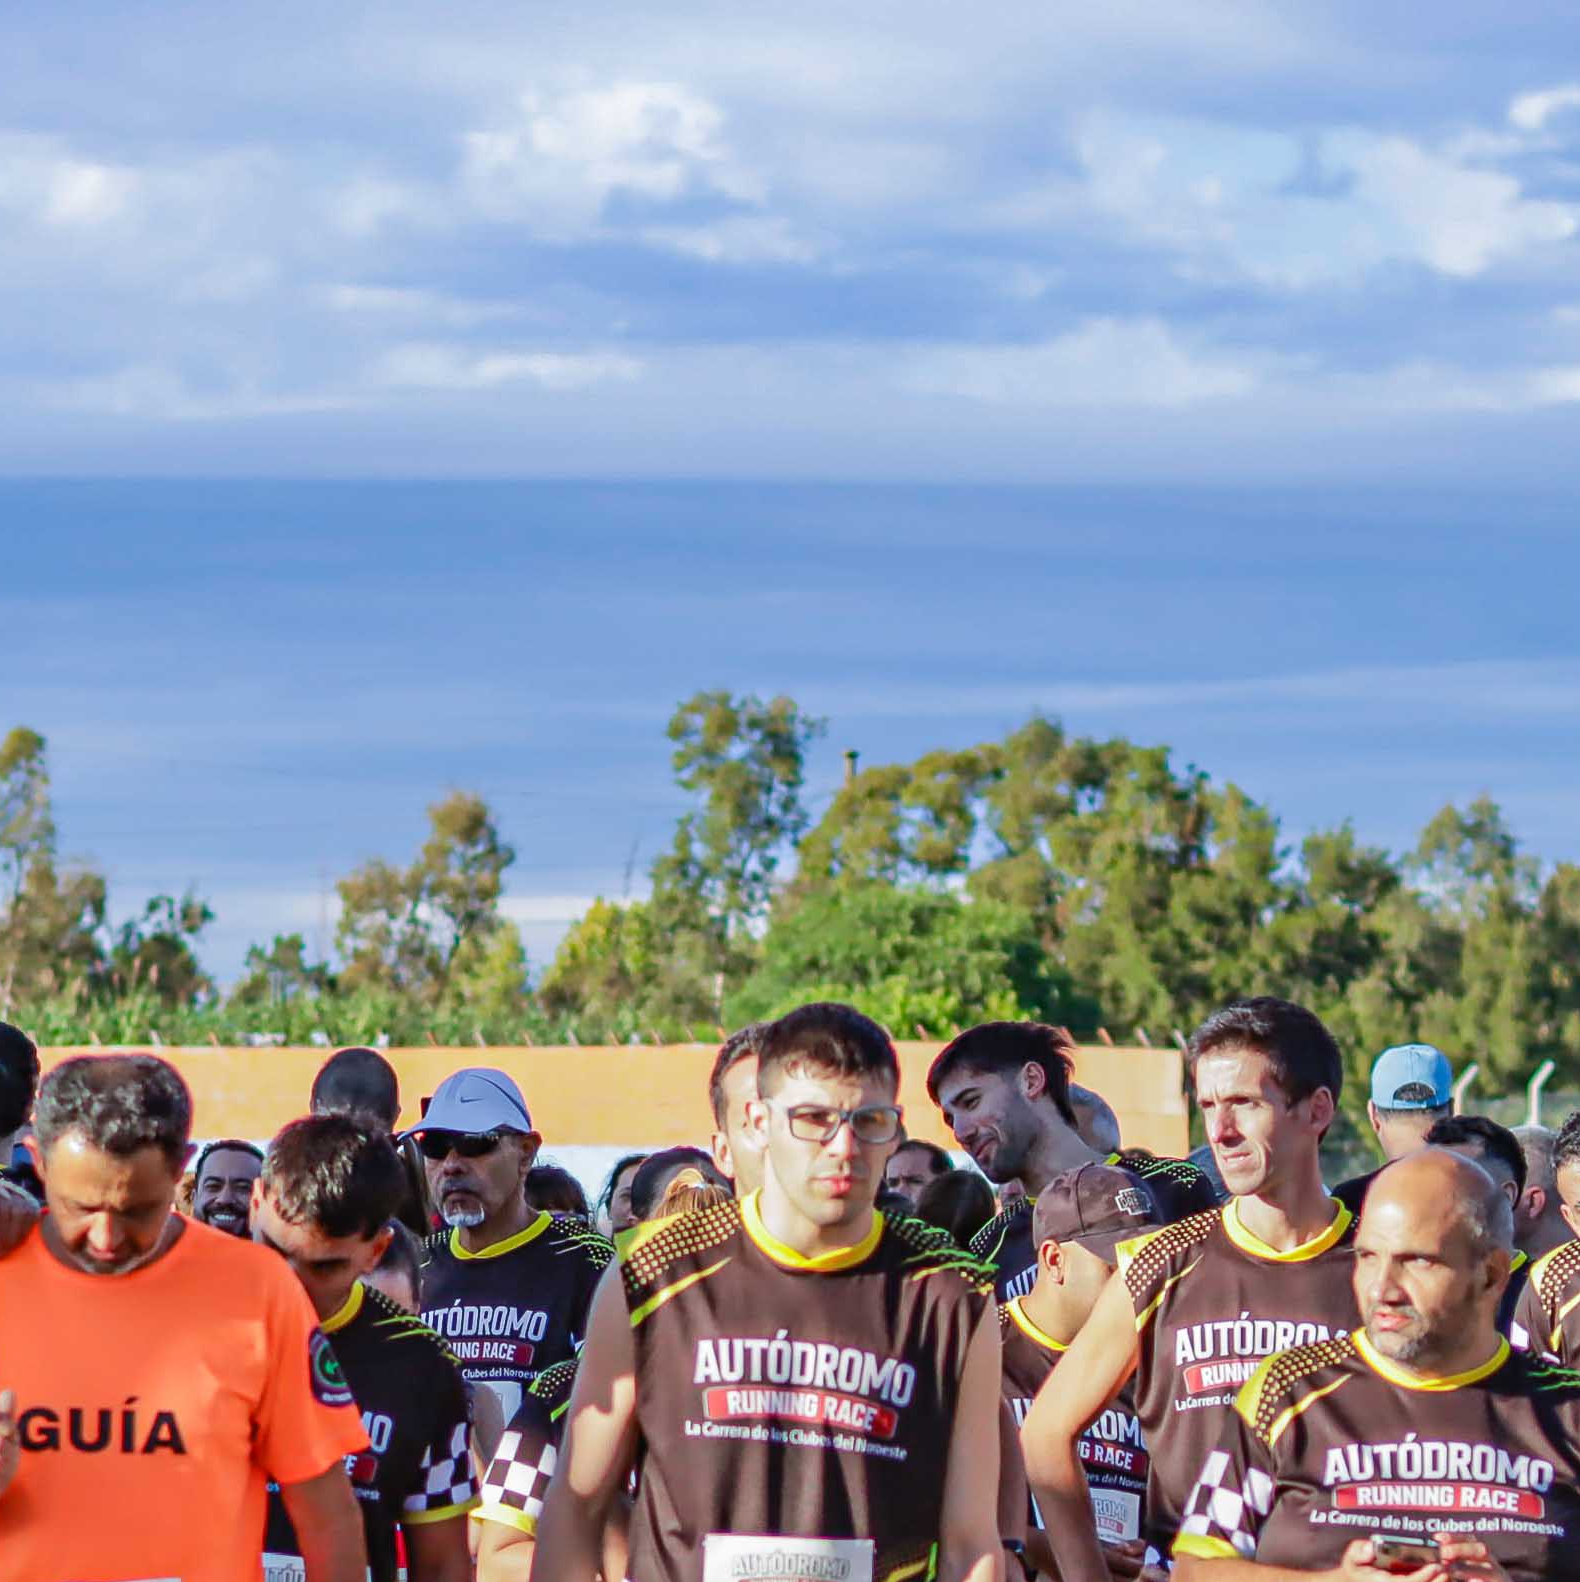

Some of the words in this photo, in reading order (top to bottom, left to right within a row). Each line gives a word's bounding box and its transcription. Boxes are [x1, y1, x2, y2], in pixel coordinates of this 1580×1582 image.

[483, 1342, 516, 1361] RACE
[462, 1368, 488, 1379] Clubes
[489, 1367, 502, 1378] del
[693, 1329, 915, 1407] AUTÓDROMO
[726, 1390, 818, 1417] RUNNING
[823, 1394, 878, 1430] RACE
[1186, 1396, 1220, 1410] Carrera
[19, 1396, 188, 1455] GUÍA
[685, 1420, 701, 1436] La
[833, 1433, 854, 1449] del
[1094, 1444, 1133, 1470] RACE
[1323, 1432, 1554, 1493] AUTÓDROMO
[1357, 1485, 1454, 1508] RUNNING
[1460, 1487, 1519, 1512] RACE
[1309, 1509, 1326, 1524] La
[1328, 1510, 1380, 1528] Carrera
[1382, 1514, 1401, 1530] de
[1403, 1515, 1424, 1531] los
[1425, 1517, 1474, 1533] Clubes
[1475, 1518, 1500, 1532] del
[1501, 1519, 1565, 1537] Noroeste
